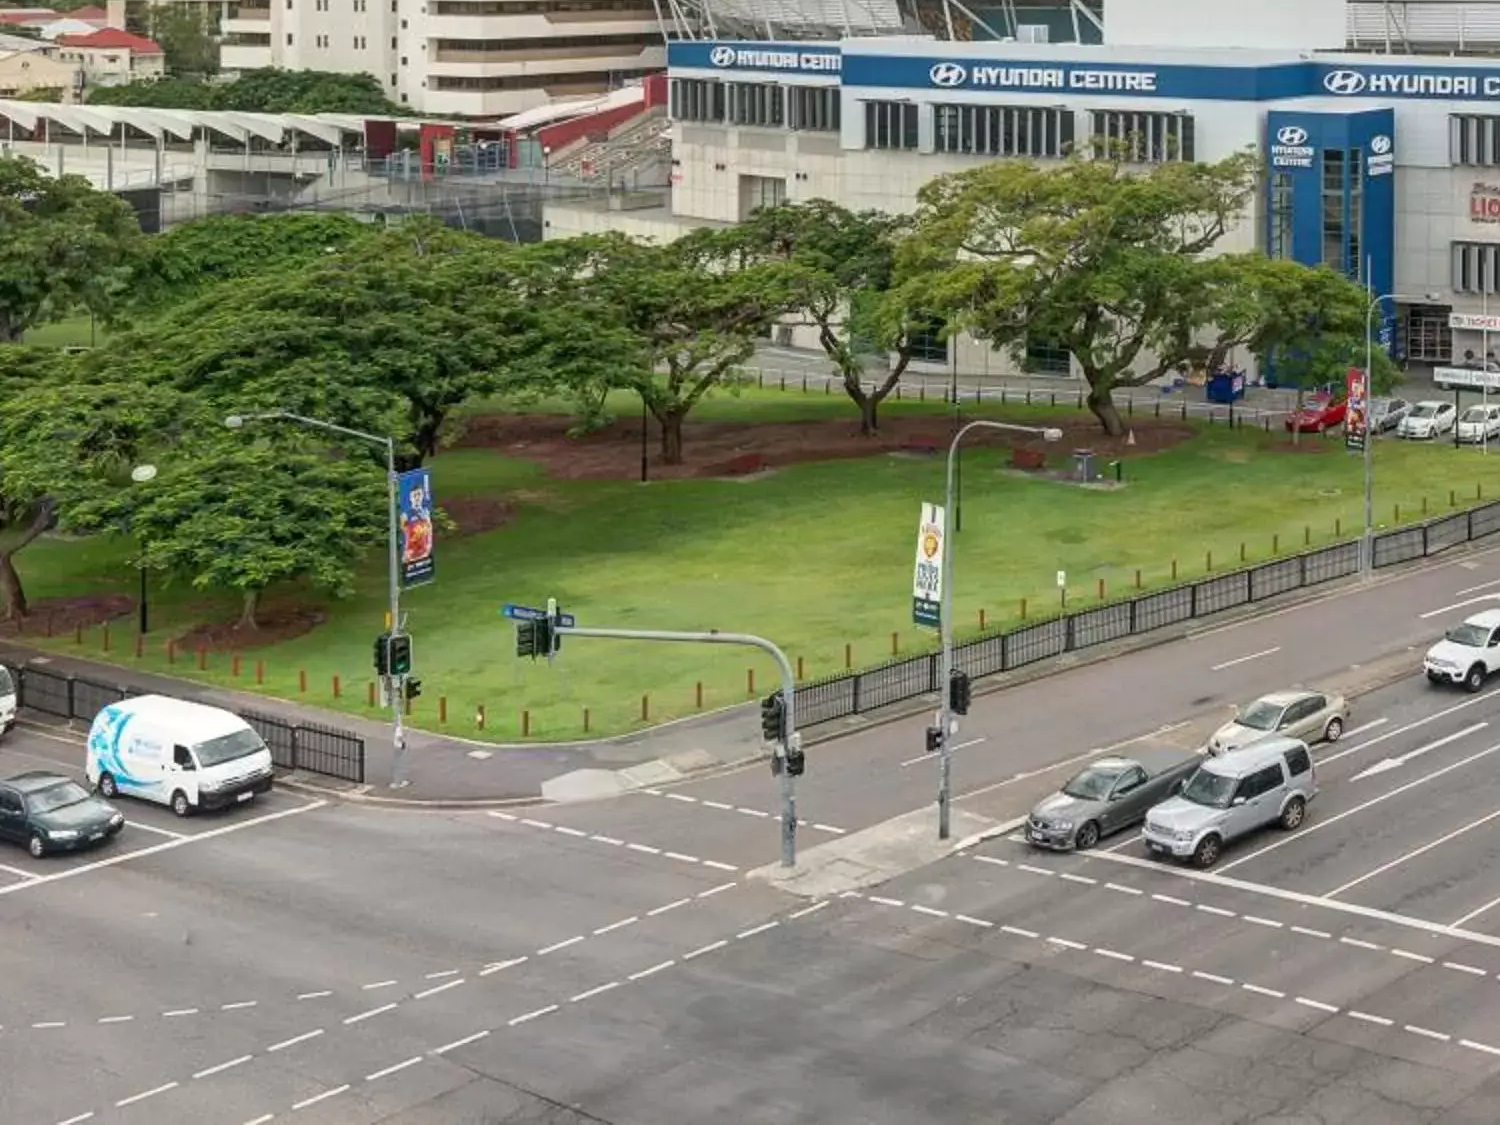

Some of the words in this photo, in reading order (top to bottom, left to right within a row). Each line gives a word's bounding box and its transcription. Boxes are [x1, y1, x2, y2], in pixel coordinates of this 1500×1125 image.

[737, 50, 798, 68] HYUNDAI
[801, 53, 842, 70] CENT
[973, 66, 1063, 87] HYUNDAI
[1069, 71, 1156, 91] CENTRE
[1369, 74, 1477, 95] HYUNDAI
[1271, 145, 1315, 156] HYUNDAI
